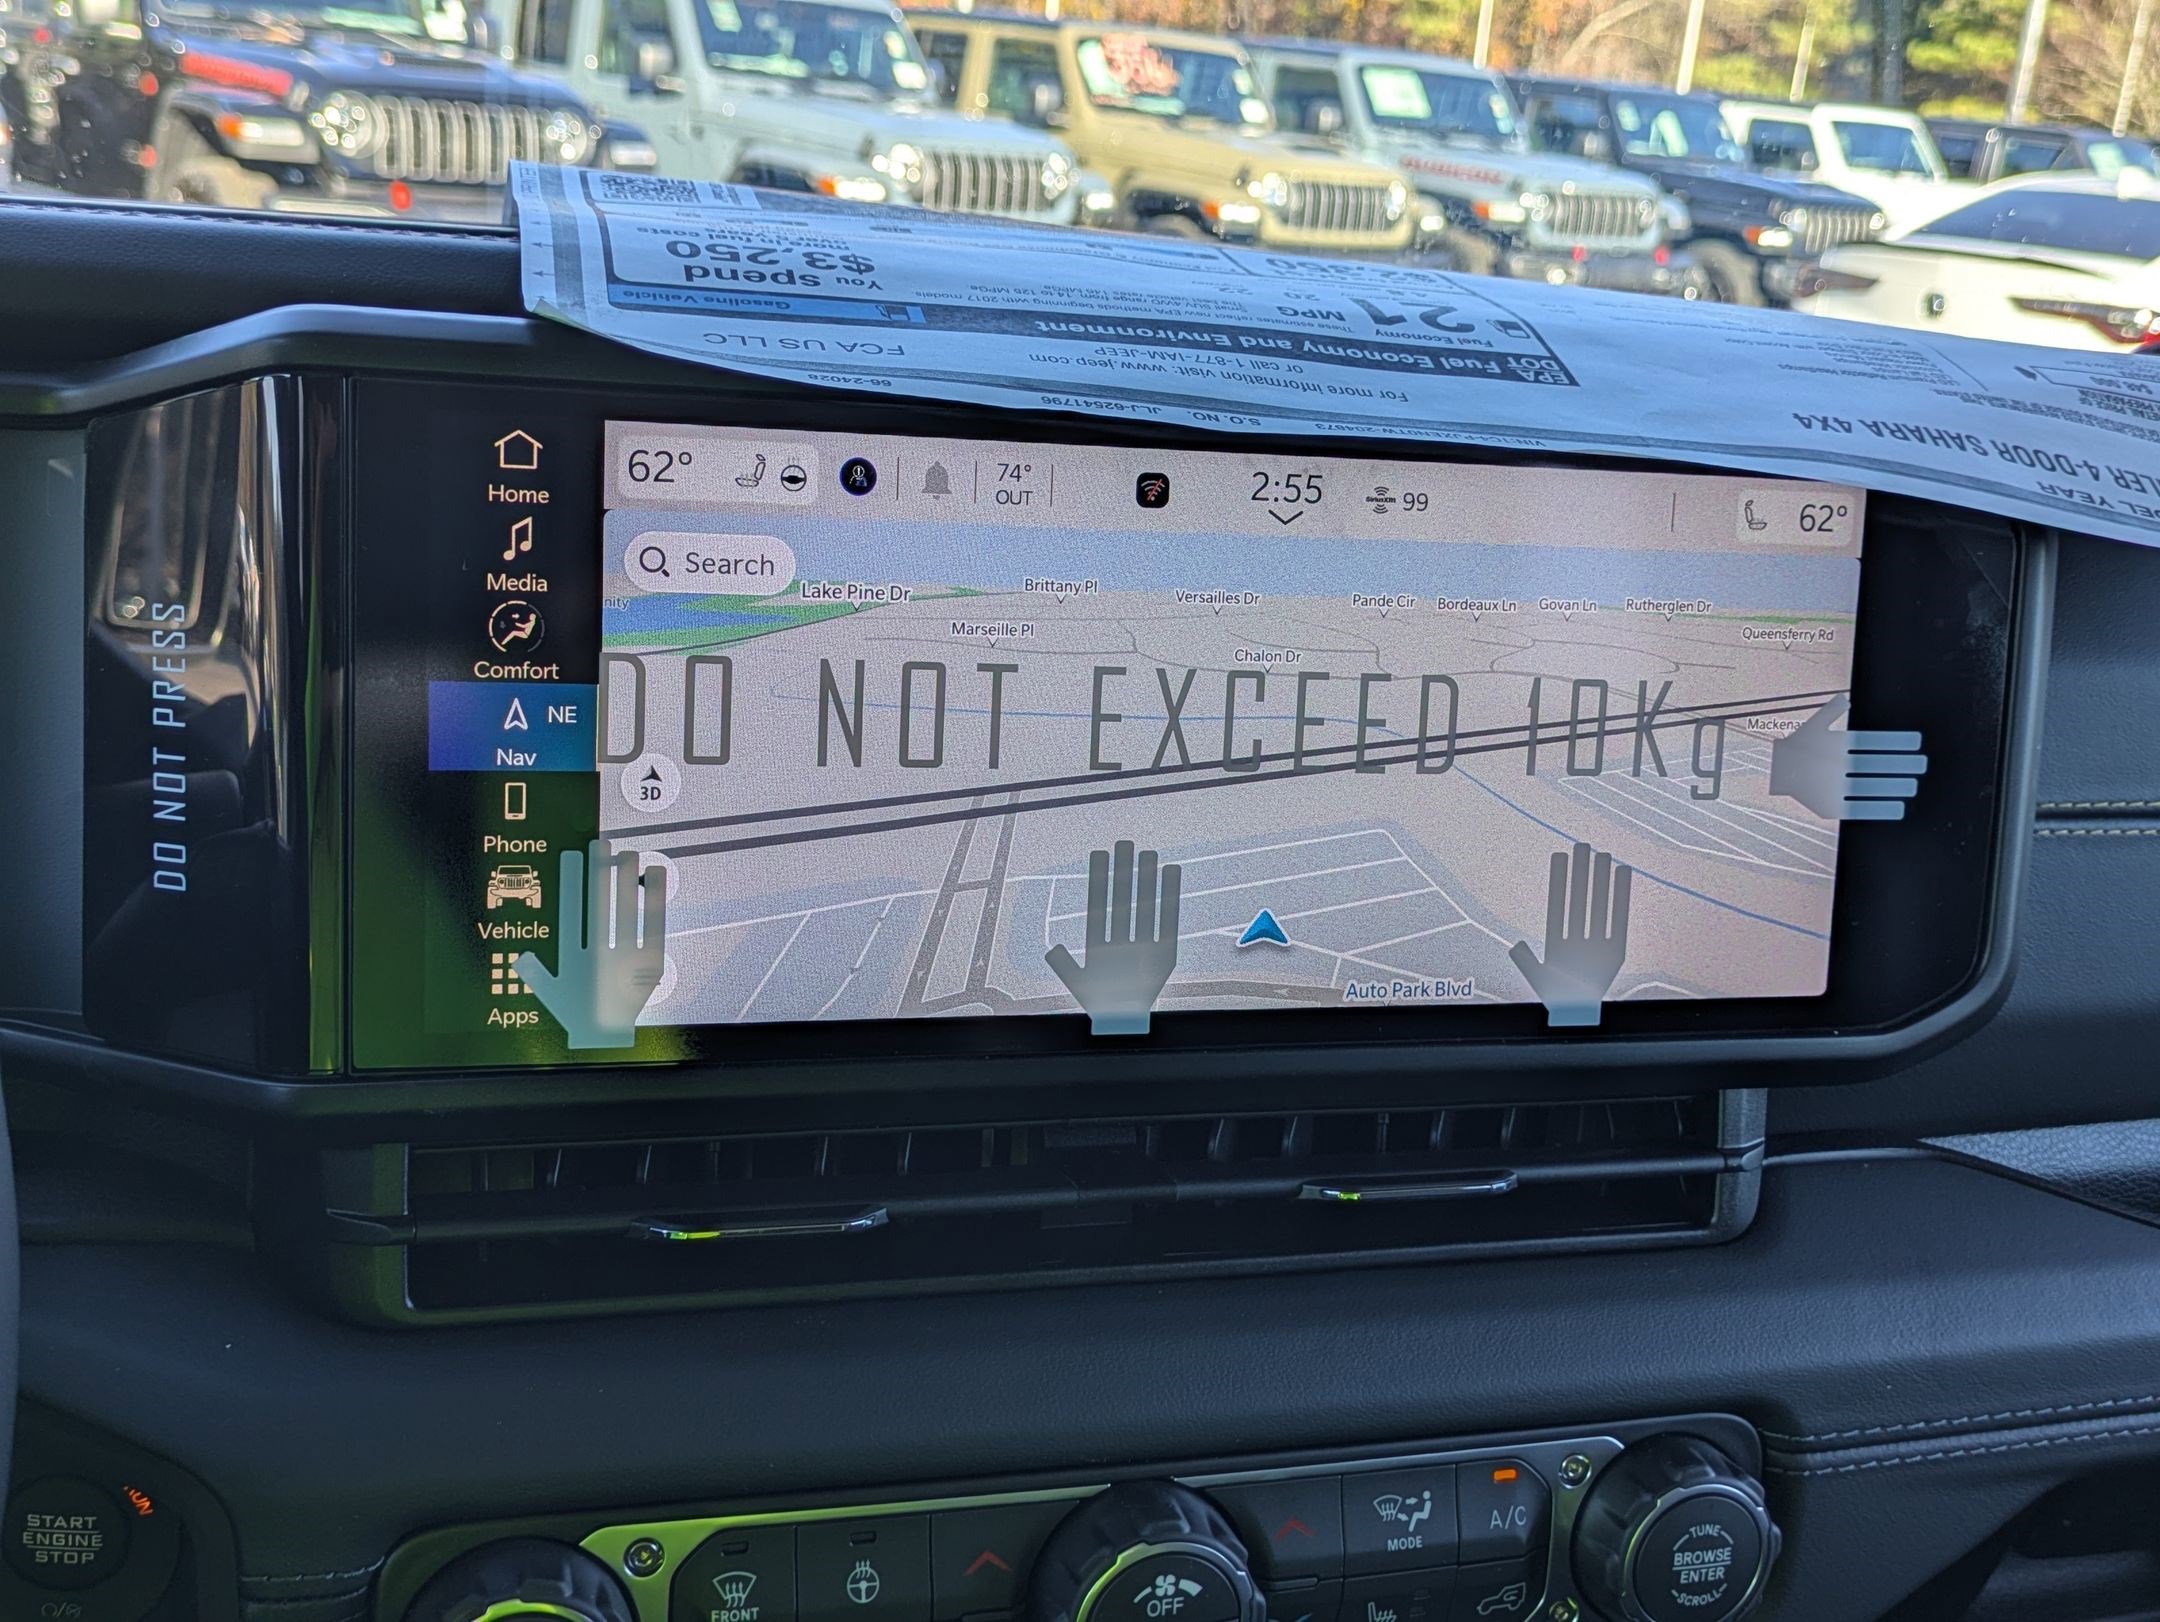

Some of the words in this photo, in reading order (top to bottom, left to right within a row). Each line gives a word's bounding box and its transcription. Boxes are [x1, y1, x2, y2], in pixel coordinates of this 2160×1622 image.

[665, 239, 875, 276] $3,250
[682, 263, 821, 288] spend
[835, 276, 883, 291] You
[622, 289, 699, 304] Vehicle
[703, 294, 791, 311] Gasoline
[1276, 305, 1346, 321] MPG
[1348, 297, 1476, 334] 21
[702, 332, 767, 348] LLC
[1034, 320, 1232, 346] Environment
[1375, 329, 1453, 346] Economy
[778, 338, 827, 352] US
[836, 341, 906, 357] FCA
[1238, 335, 1292, 354] and
[1456, 336, 1493, 349] Fuel
[1028, 352, 1168, 374] www.jeep.com
[1093, 346, 1245, 370] 1-877-IAM-JEEP
[1303, 339, 1435, 369] Economy
[1171, 365, 1216, 380] visit:
[1248, 358, 1280, 374] call
[1284, 364, 1304, 375] or
[1439, 355, 1498, 374] Fuel
[1506, 356, 1560, 371] DOT
[1220, 370, 1322, 396] information
[1515, 370, 1570, 385] EPA
[1326, 384, 1374, 400] more
[1379, 389, 1409, 403] For
[1791, 412, 1852, 434] 4X4
[1857, 418, 1989, 457] SAHARA
[628, 449, 693, 484] 62°
[1989, 439, 2100, 482] 4-DOOR
[997, 463, 1033, 483] 74°
[2105, 465, 2160, 498] LER
[488, 484, 549, 503] Home
[1251, 471, 1323, 504] 2:55
[2035, 481, 2115, 511] YEAR
[995, 489, 1034, 506] OUT
[1403, 492, 1429, 512] 99
[1799, 503, 1848, 533] 62°
[685, 552, 775, 576] Search
[487, 573, 549, 592] Media
[802, 582, 843, 600] Lake
[847, 583, 885, 601] Pine
[890, 585, 911, 601] Dr
[1024, 578, 1082, 596] Brittany
[1085, 579, 1098, 594] Pl
[1175, 589, 1240, 605] Versailles
[1244, 592, 1260, 605] Dr
[1352, 594, 1393, 608] Pande
[1396, 595, 1416, 608] Cir
[1437, 597, 1498, 611] Bordeaux
[1502, 599, 1517, 612] Ln
[1539, 599, 1579, 612] Govan
[1583, 599, 1597, 612] Ln
[1626, 598, 1693, 615] Rutherglen
[1696, 600, 1712, 613] Dr
[951, 621, 1018, 637] Marseille
[1022, 623, 1034, 637] Pl
[1742, 627, 1815, 644] Queensferry
[1818, 628, 1834, 642] Rd
[152, 602, 186, 728] PRESS
[1234, 650, 1281, 663] Chalon
[1285, 650, 1302, 663] Dr
[474, 660, 560, 680] Comfort
[548, 706, 577, 724] NE
[597, 652, 733, 765] DO
[817, 657, 1020, 770] NOT
[1089, 665, 1460, 776] EXCEED
[1525, 677, 1727, 801] 10Kg
[496, 748, 537, 766] Nav
[153, 747, 186, 822] NOT
[639, 786, 662, 801] 3D
[484, 836, 547, 853] Phone
[153, 842, 186, 892] DO
[477, 921, 550, 939] Vehicle
[1346, 982, 1388, 999] Auto
[1391, 981, 1430, 998] Park
[1434, 980, 1473, 997] Blvd
[487, 1007, 539, 1027] Apps
[26, 1513, 98, 1529] START
[1489, 1505, 1527, 1529] A/C
[22, 1531, 104, 1548] ENGINE
[1689, 1524, 1721, 1538] TUNE
[1387, 1536, 1423, 1552] MODE
[35, 1550, 95, 1565] STOP
[1673, 1546, 1732, 1566] BROWSE
[1680, 1566, 1726, 1584] ENTER
[1146, 1596, 1185, 1618] OFF
[1677, 1589, 1722, 1607] SCROLL
[711, 1606, 760, 1622] FRONT
